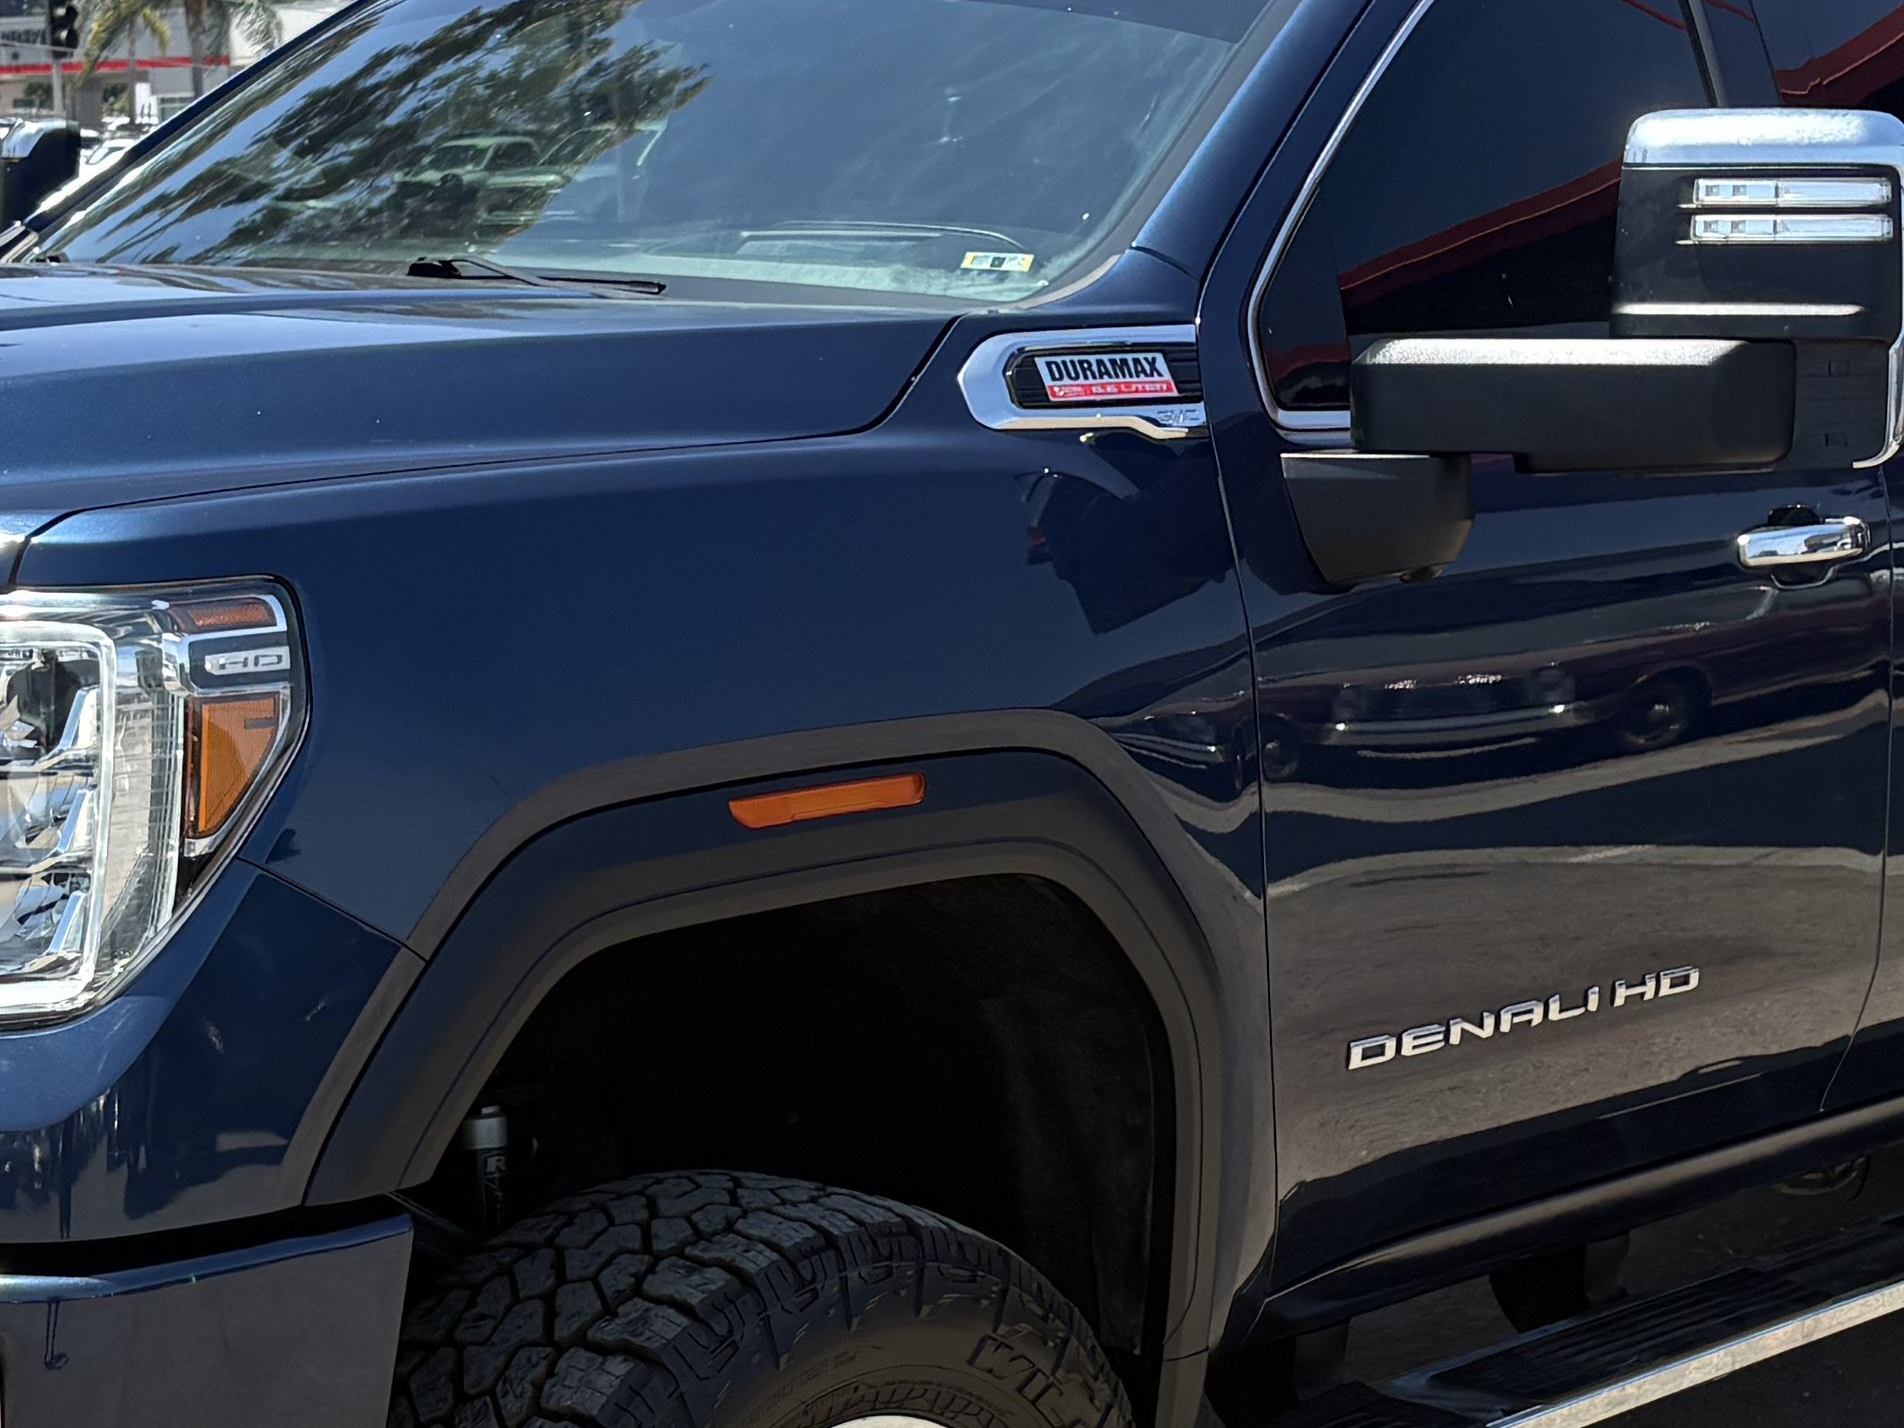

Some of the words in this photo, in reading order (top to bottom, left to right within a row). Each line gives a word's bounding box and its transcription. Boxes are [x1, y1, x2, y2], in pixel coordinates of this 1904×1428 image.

[1045, 356, 1164, 382] DURAMAX
[217, 654, 283, 670] HD
[1348, 986, 1600, 1070] DENALI
[1612, 966, 1700, 1008] HD
